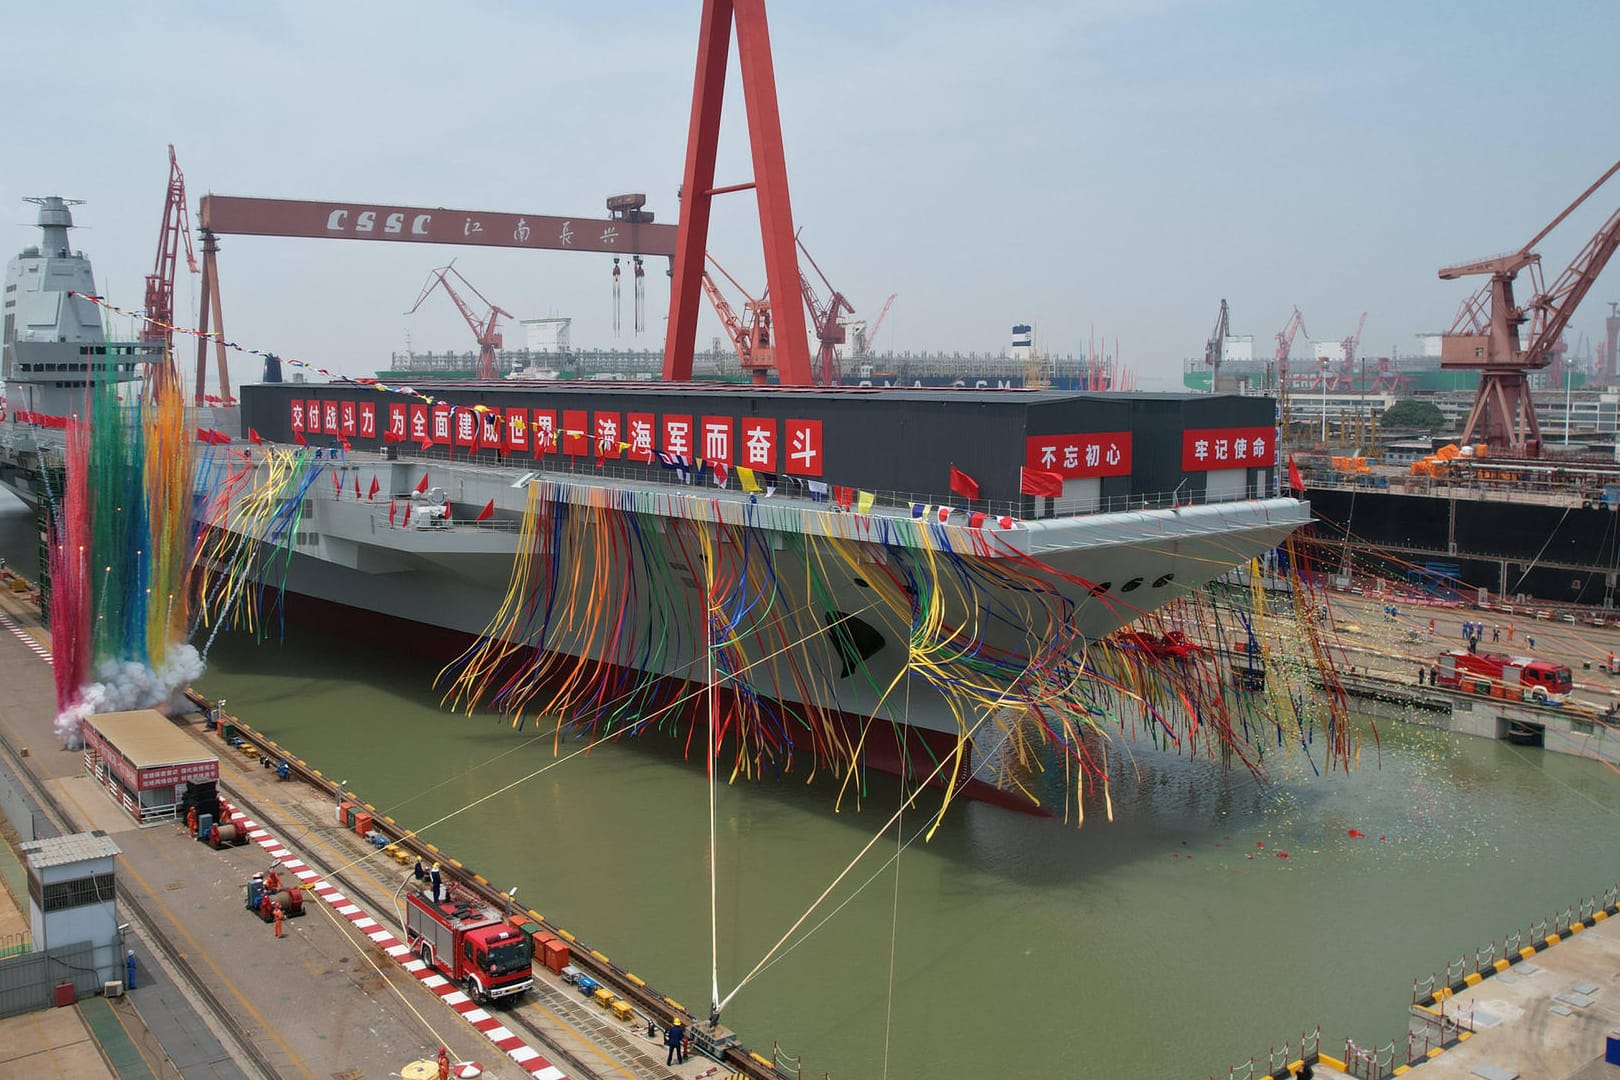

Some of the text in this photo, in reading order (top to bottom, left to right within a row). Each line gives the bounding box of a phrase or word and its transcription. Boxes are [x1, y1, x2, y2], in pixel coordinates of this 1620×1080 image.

[326, 209, 432, 235] CSSC
[292, 404, 817, 468] 交付战斗力 为全面建成世界一流海军而奋斗
[1194, 436, 1266, 462] 牢记使命
[1041, 442, 1121, 469] 不忘初心
